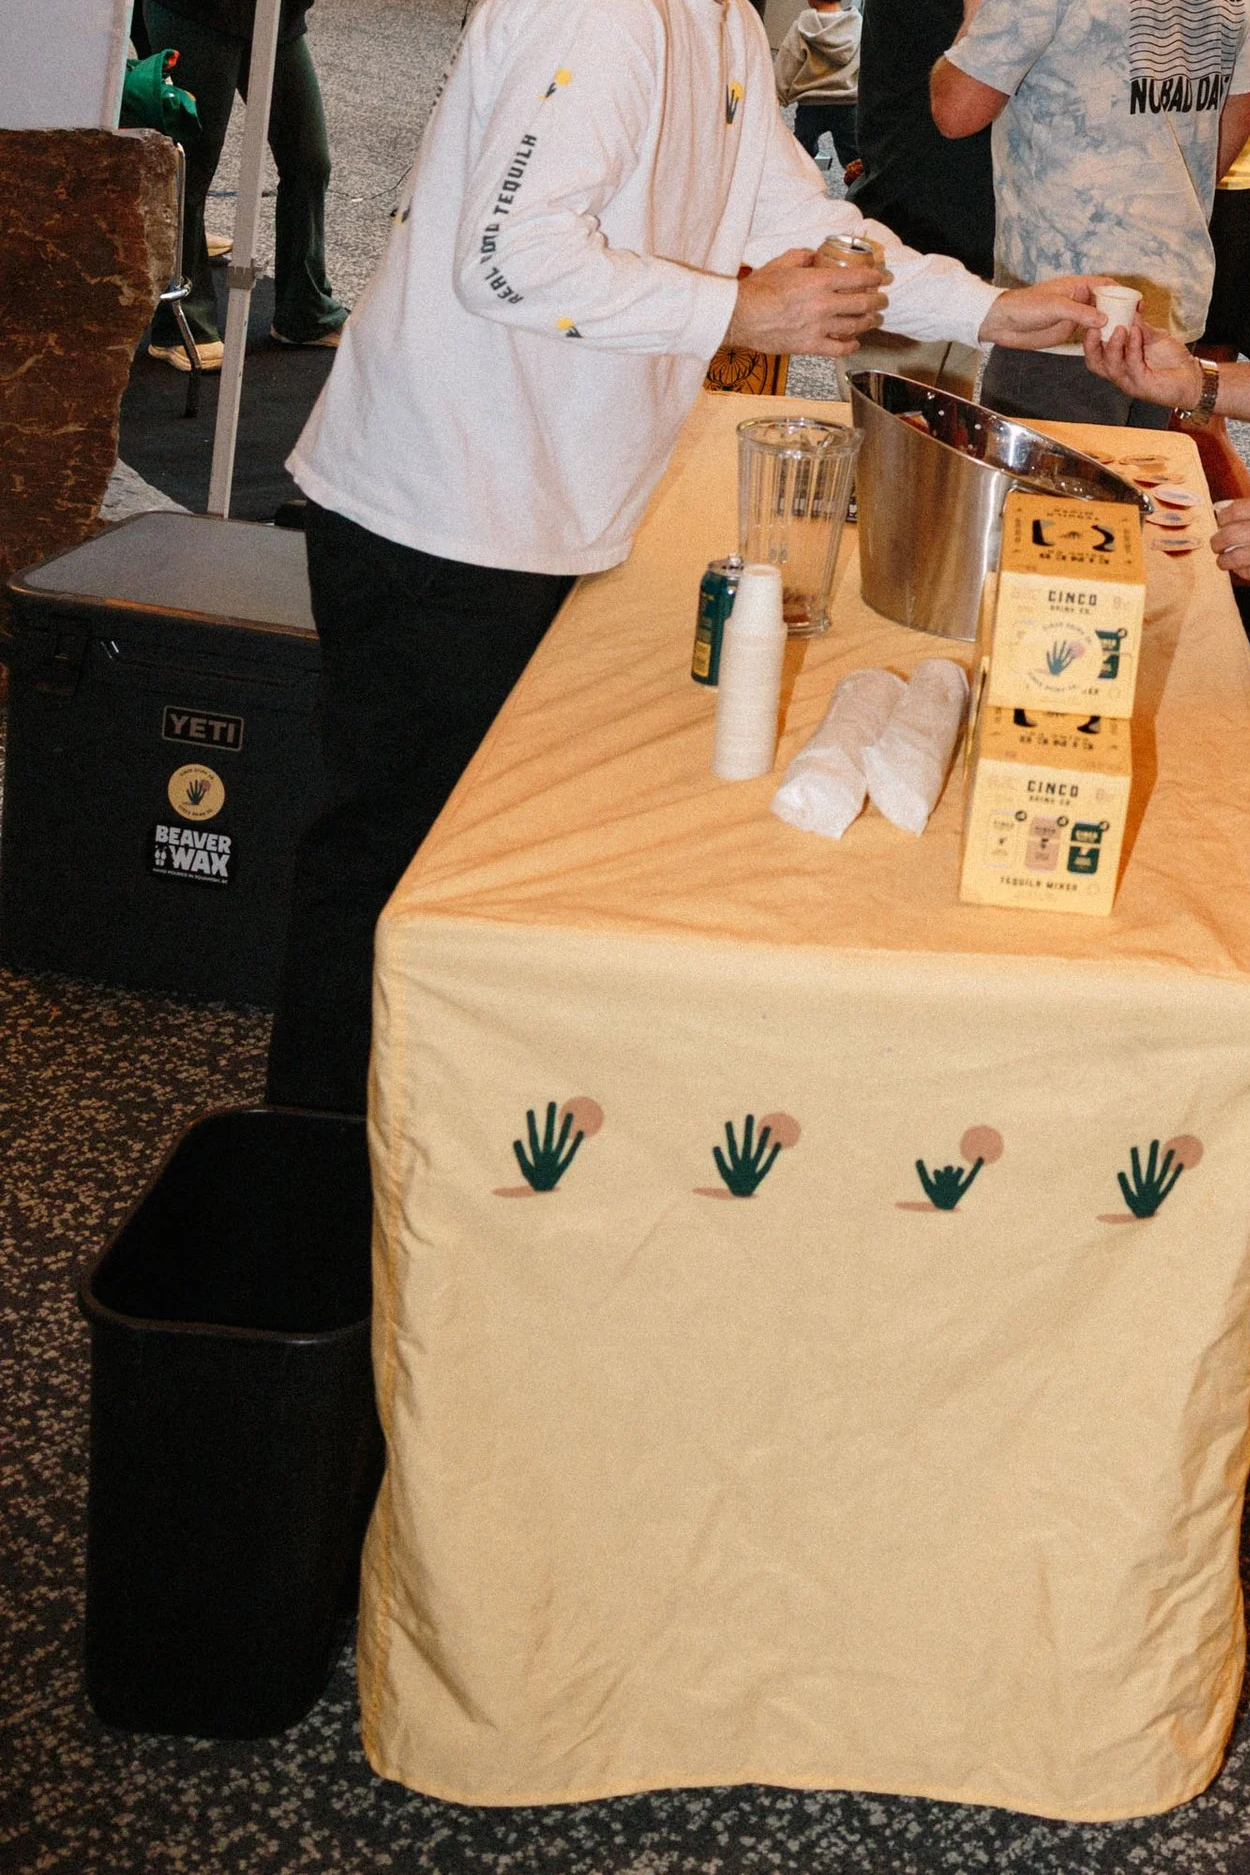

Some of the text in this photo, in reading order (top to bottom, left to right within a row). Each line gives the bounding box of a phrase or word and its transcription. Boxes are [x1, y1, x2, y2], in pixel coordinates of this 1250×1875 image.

[492, 133, 538, 215] TEQUILA
[484, 266, 525, 305] REAL
[1047, 589, 1098, 607] CINCO
[169, 712, 237, 744] YETI
[1027, 779, 1080, 798] CINCO
[154, 824, 233, 855] BEAVER
[168, 845, 232, 877] WAX
